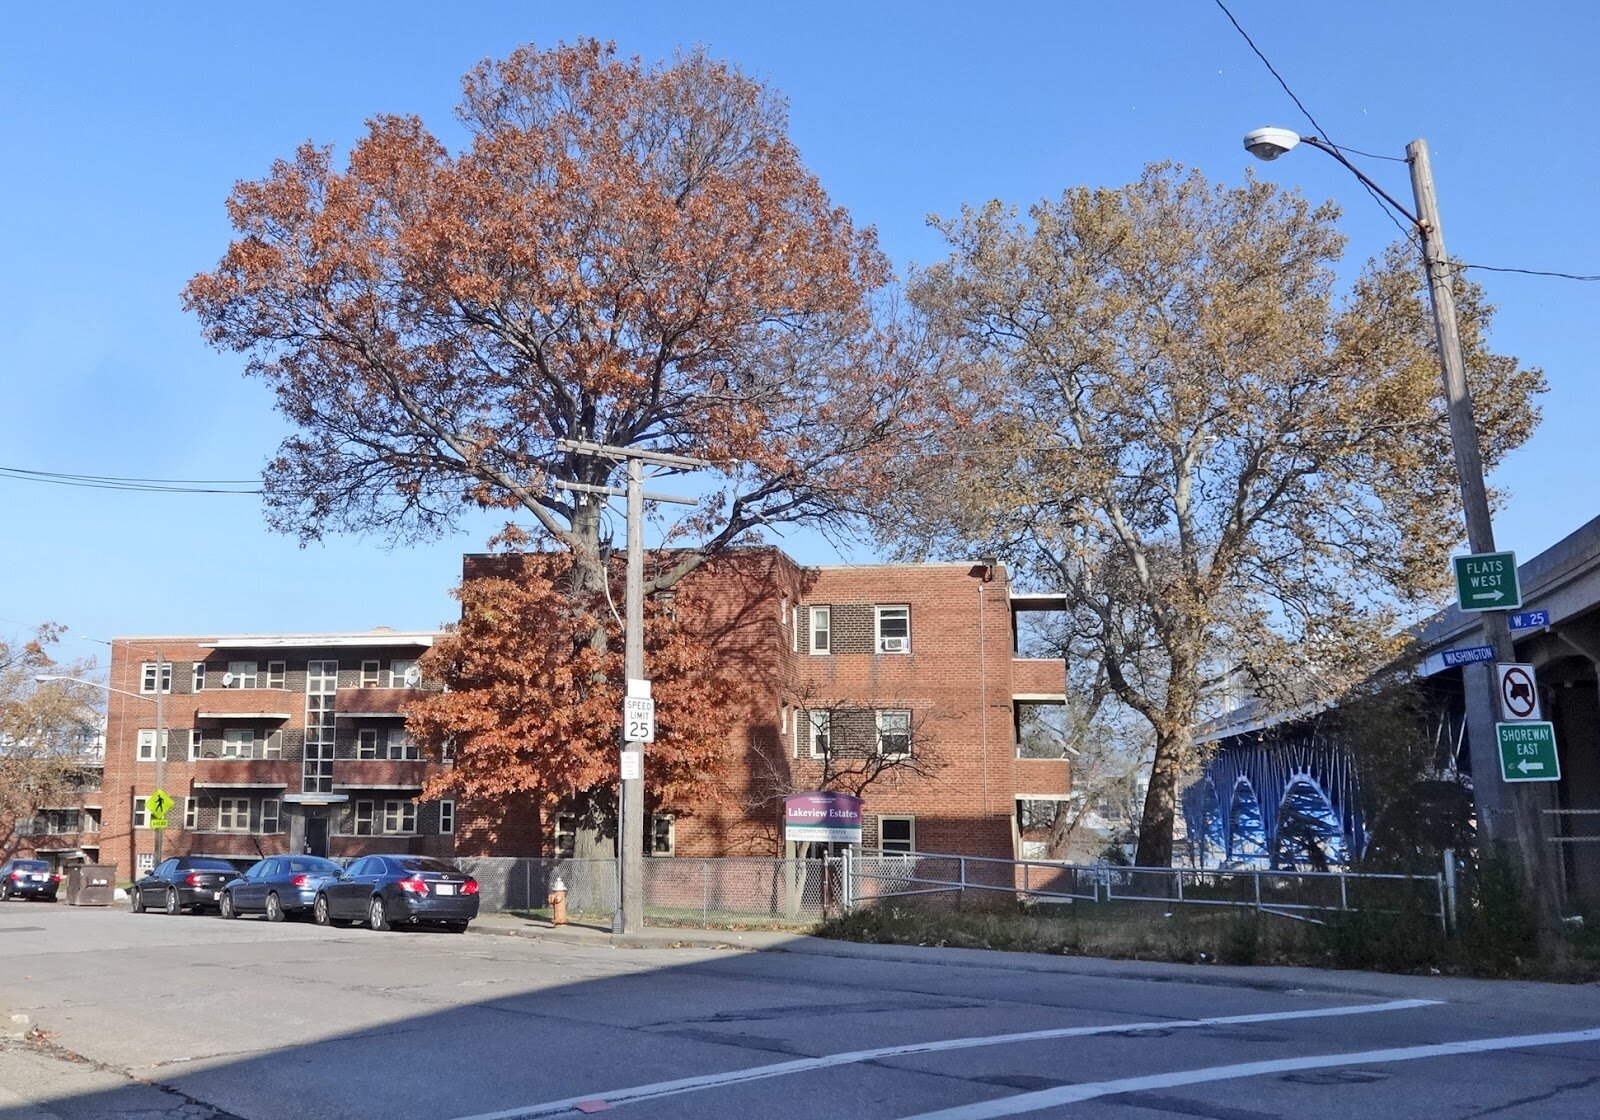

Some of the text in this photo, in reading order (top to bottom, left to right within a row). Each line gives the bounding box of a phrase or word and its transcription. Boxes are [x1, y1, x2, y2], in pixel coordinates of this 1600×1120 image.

[1466, 560, 1504, 574] FLATS
[1470, 574, 1503, 588] WEST
[1530, 612, 1545, 625] 25
[1445, 648, 1493, 664] WASHINGTON
[627, 700, 652, 711] SPEED
[630, 711, 650, 720] LIMIT
[630, 721, 649, 738] 25
[1502, 728, 1550, 742] SHOREWAY
[1516, 743, 1539, 756] EAST
[788, 807, 858, 818] Lakeview Estates
